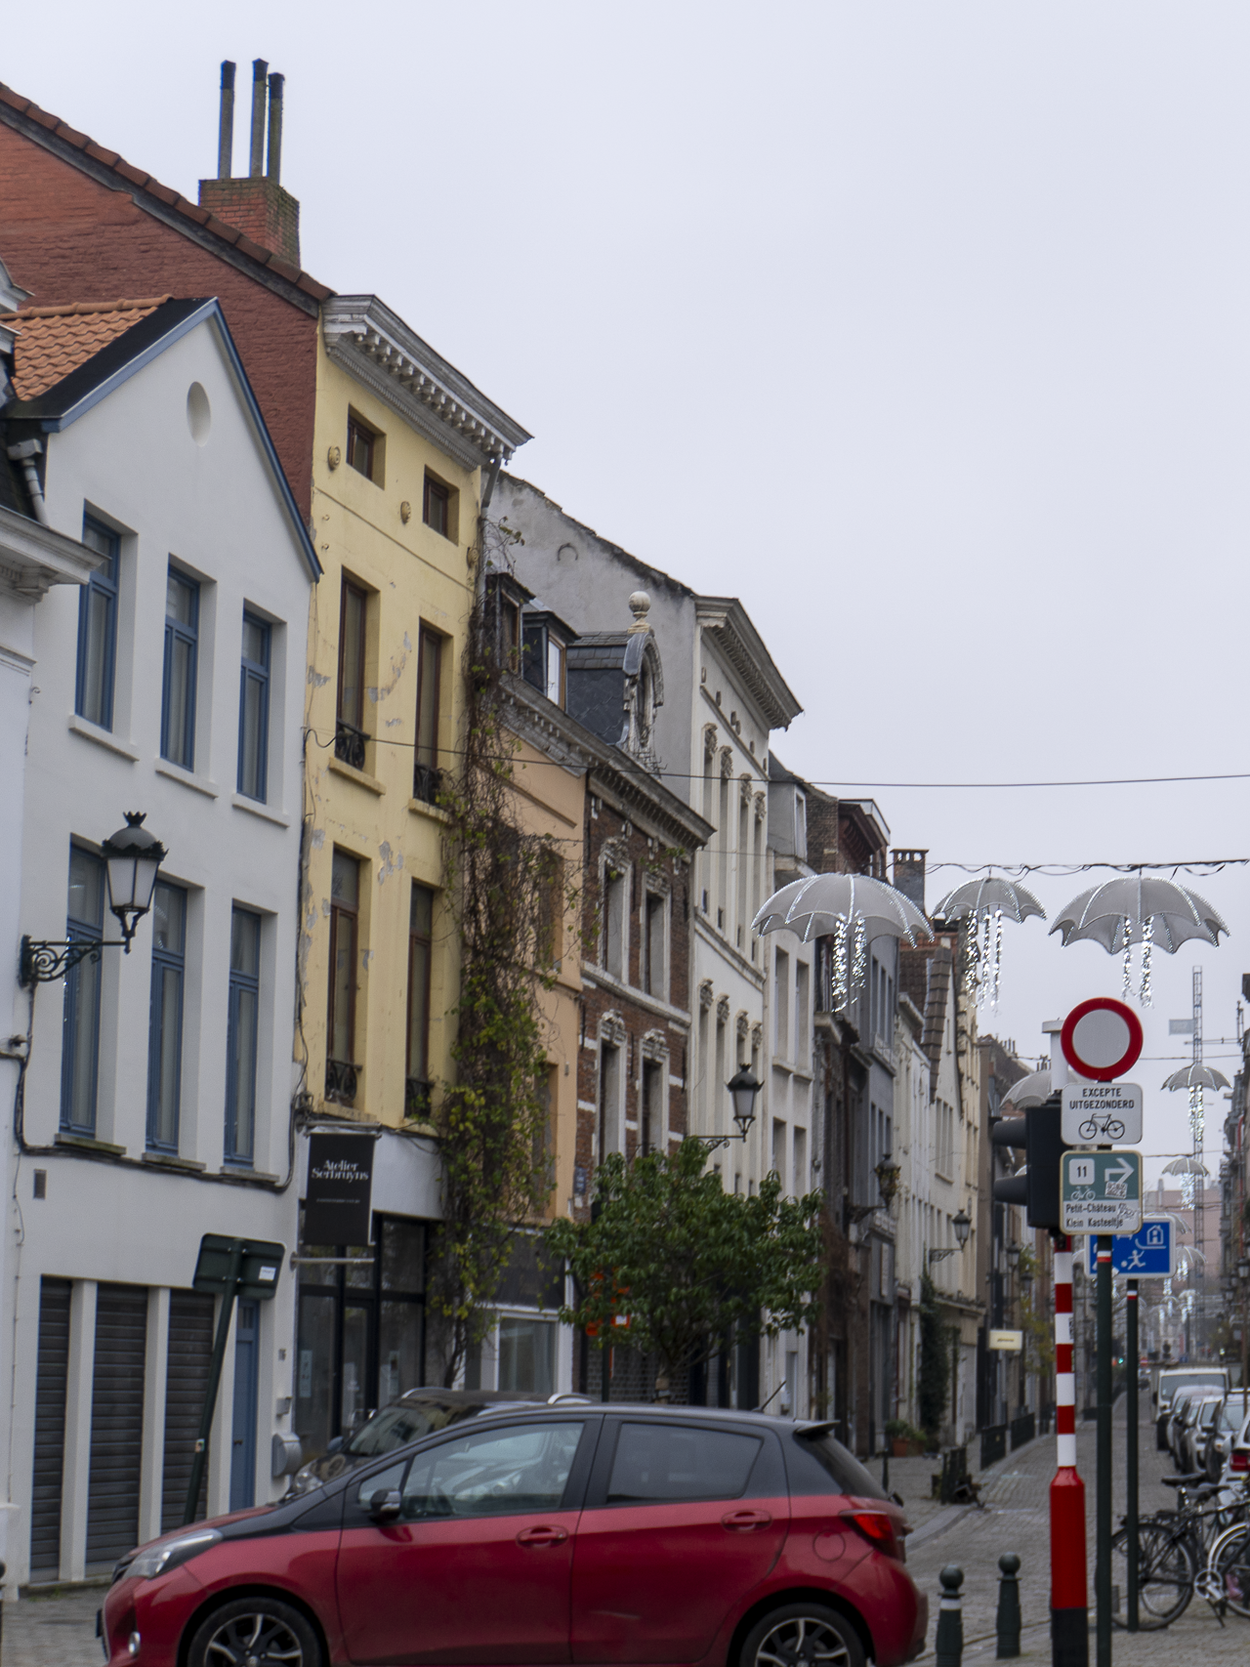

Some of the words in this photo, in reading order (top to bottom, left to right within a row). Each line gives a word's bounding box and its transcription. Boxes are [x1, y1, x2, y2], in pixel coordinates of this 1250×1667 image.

[1082, 1087, 1122, 1098] EXCEPTE
[1069, 1100, 1135, 1110] UITGEZONDERD
[323, 1159, 359, 1172] Atelier
[1077, 1165, 1087, 1178] 11
[311, 1167, 369, 1184] Serbruyns
[1066, 1218, 1084, 1228] Klein
[1088, 1217, 1124, 1229] Kasteeltje
